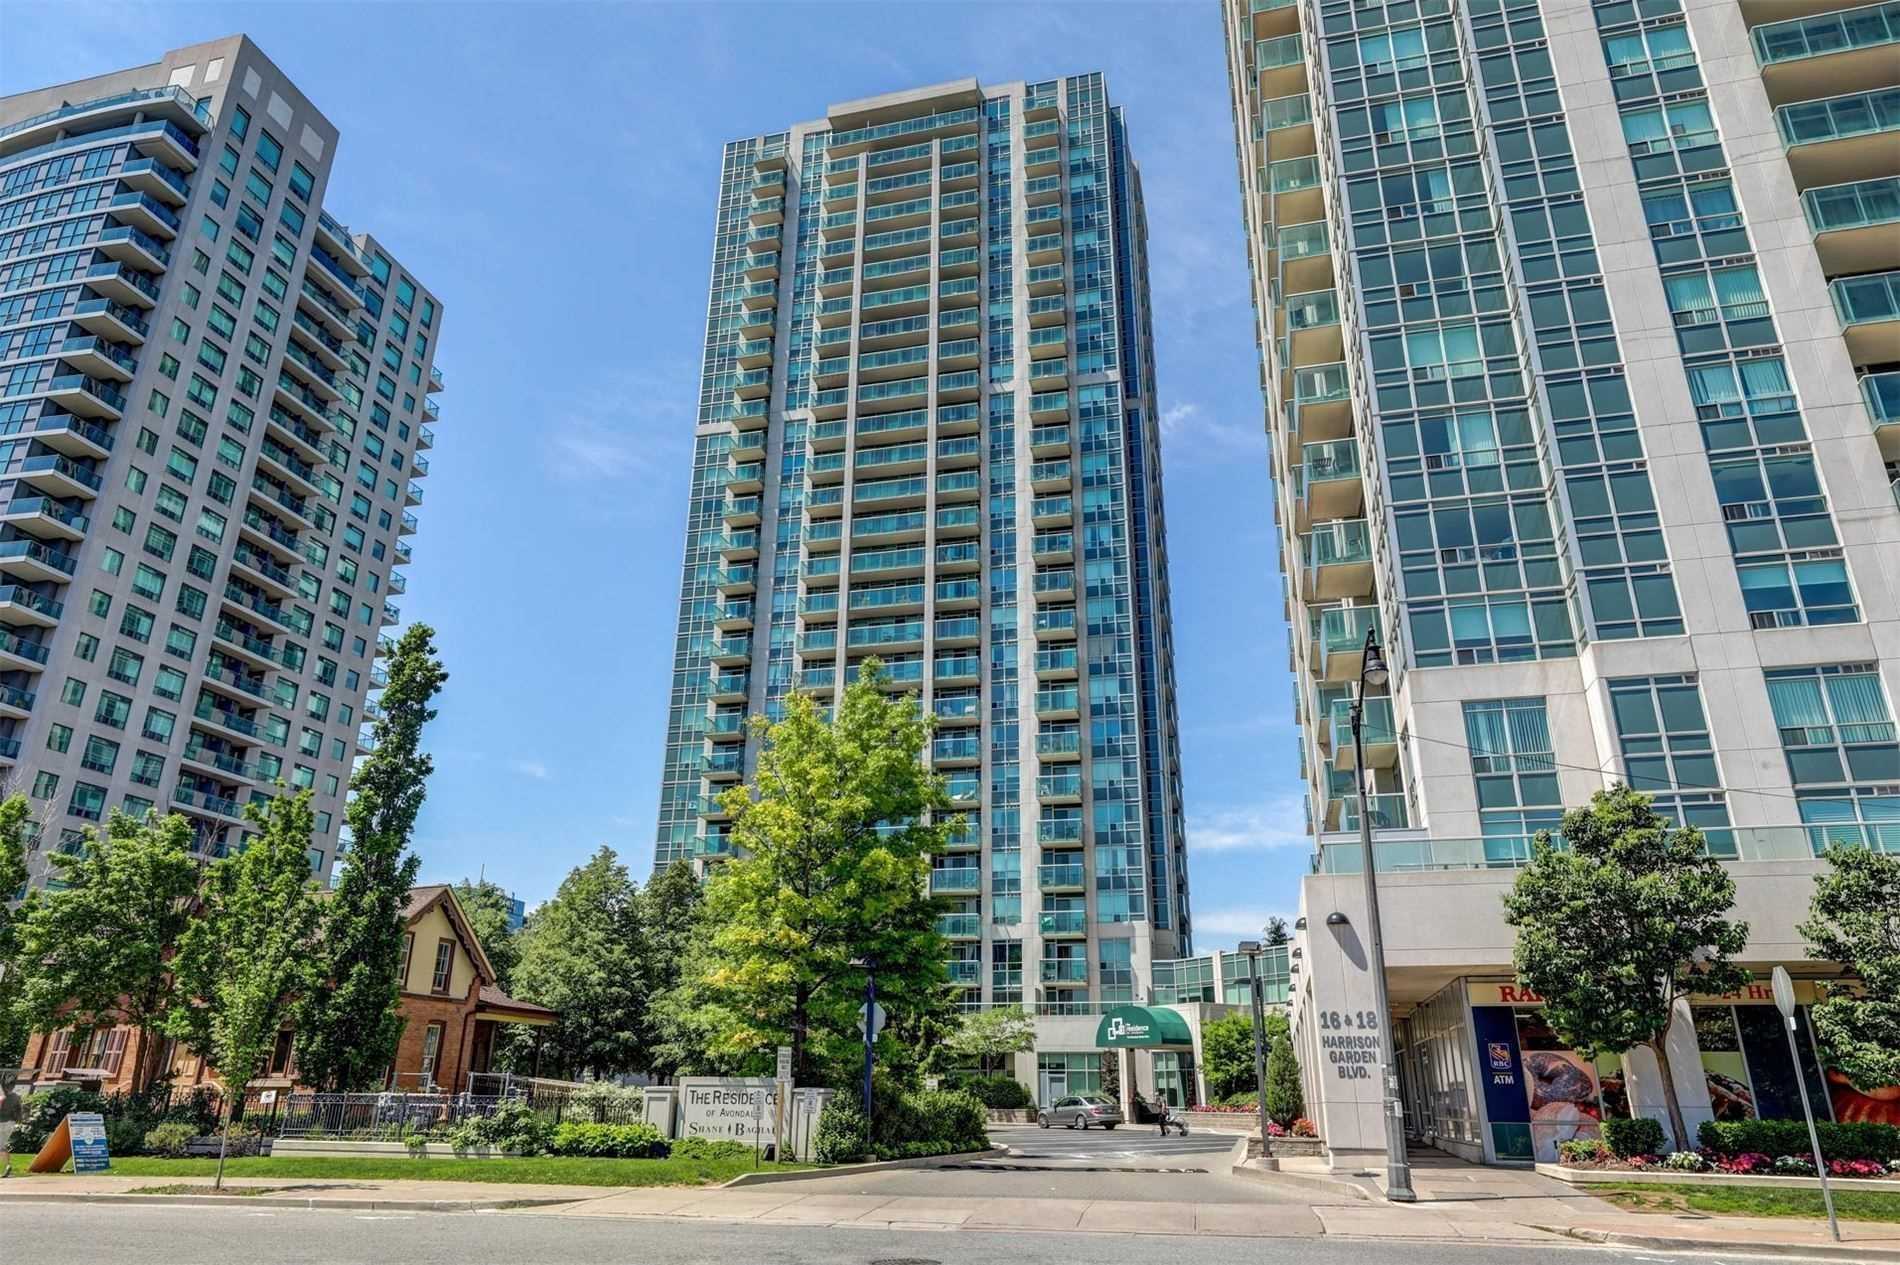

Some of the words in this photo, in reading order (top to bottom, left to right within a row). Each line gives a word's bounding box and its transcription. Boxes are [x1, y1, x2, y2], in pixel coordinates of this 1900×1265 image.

[1320, 1011, 1341, 1030] 16
[1344, 1014, 1353, 1026] &
[1356, 1011, 1378, 1030] 18
[1322, 1035, 1380, 1049] HARRISON
[1329, 1050, 1377, 1064] GARDEN
[1338, 1066, 1371, 1079] BLVD.
[1493, 1075, 1514, 1085] ATM
[689, 1090, 711, 1105] THE
[713, 1090, 778, 1105] RESIDECE
[706, 1109, 716, 1117] OF
[719, 1108, 755, 1118] AVONDAL
